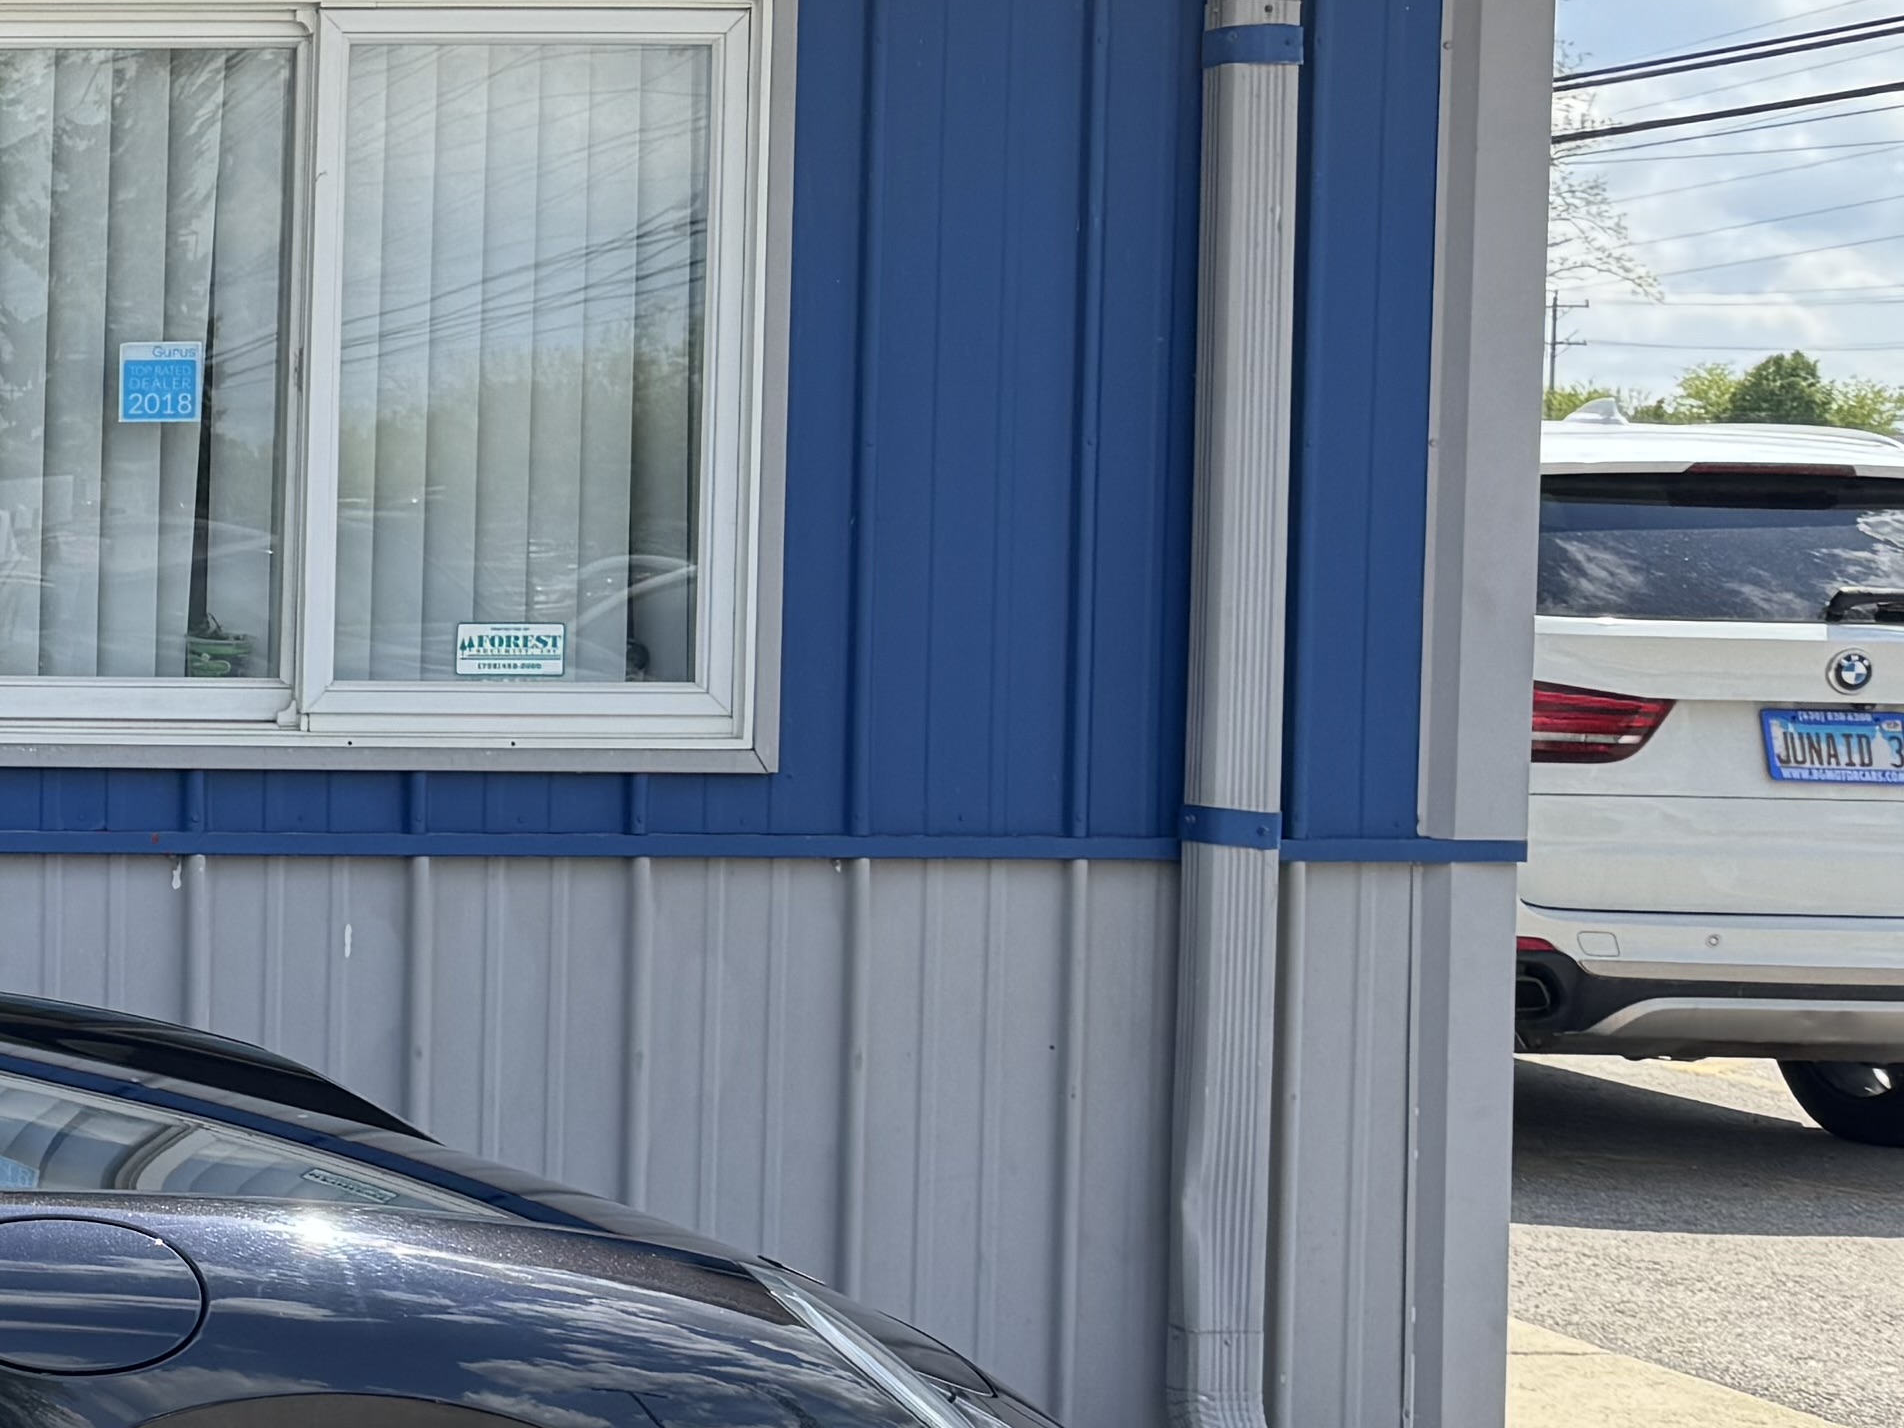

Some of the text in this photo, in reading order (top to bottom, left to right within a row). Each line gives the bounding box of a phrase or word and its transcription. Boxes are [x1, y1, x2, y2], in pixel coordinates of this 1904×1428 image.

[152, 345, 197, 359] Gurus
[154, 364, 191, 377] RATED
[128, 376, 191, 391] DEALER
[128, 392, 192, 414] 2018
[478, 634, 562, 648] FOREST
[1776, 731, 1904, 769] JUNAID 3
